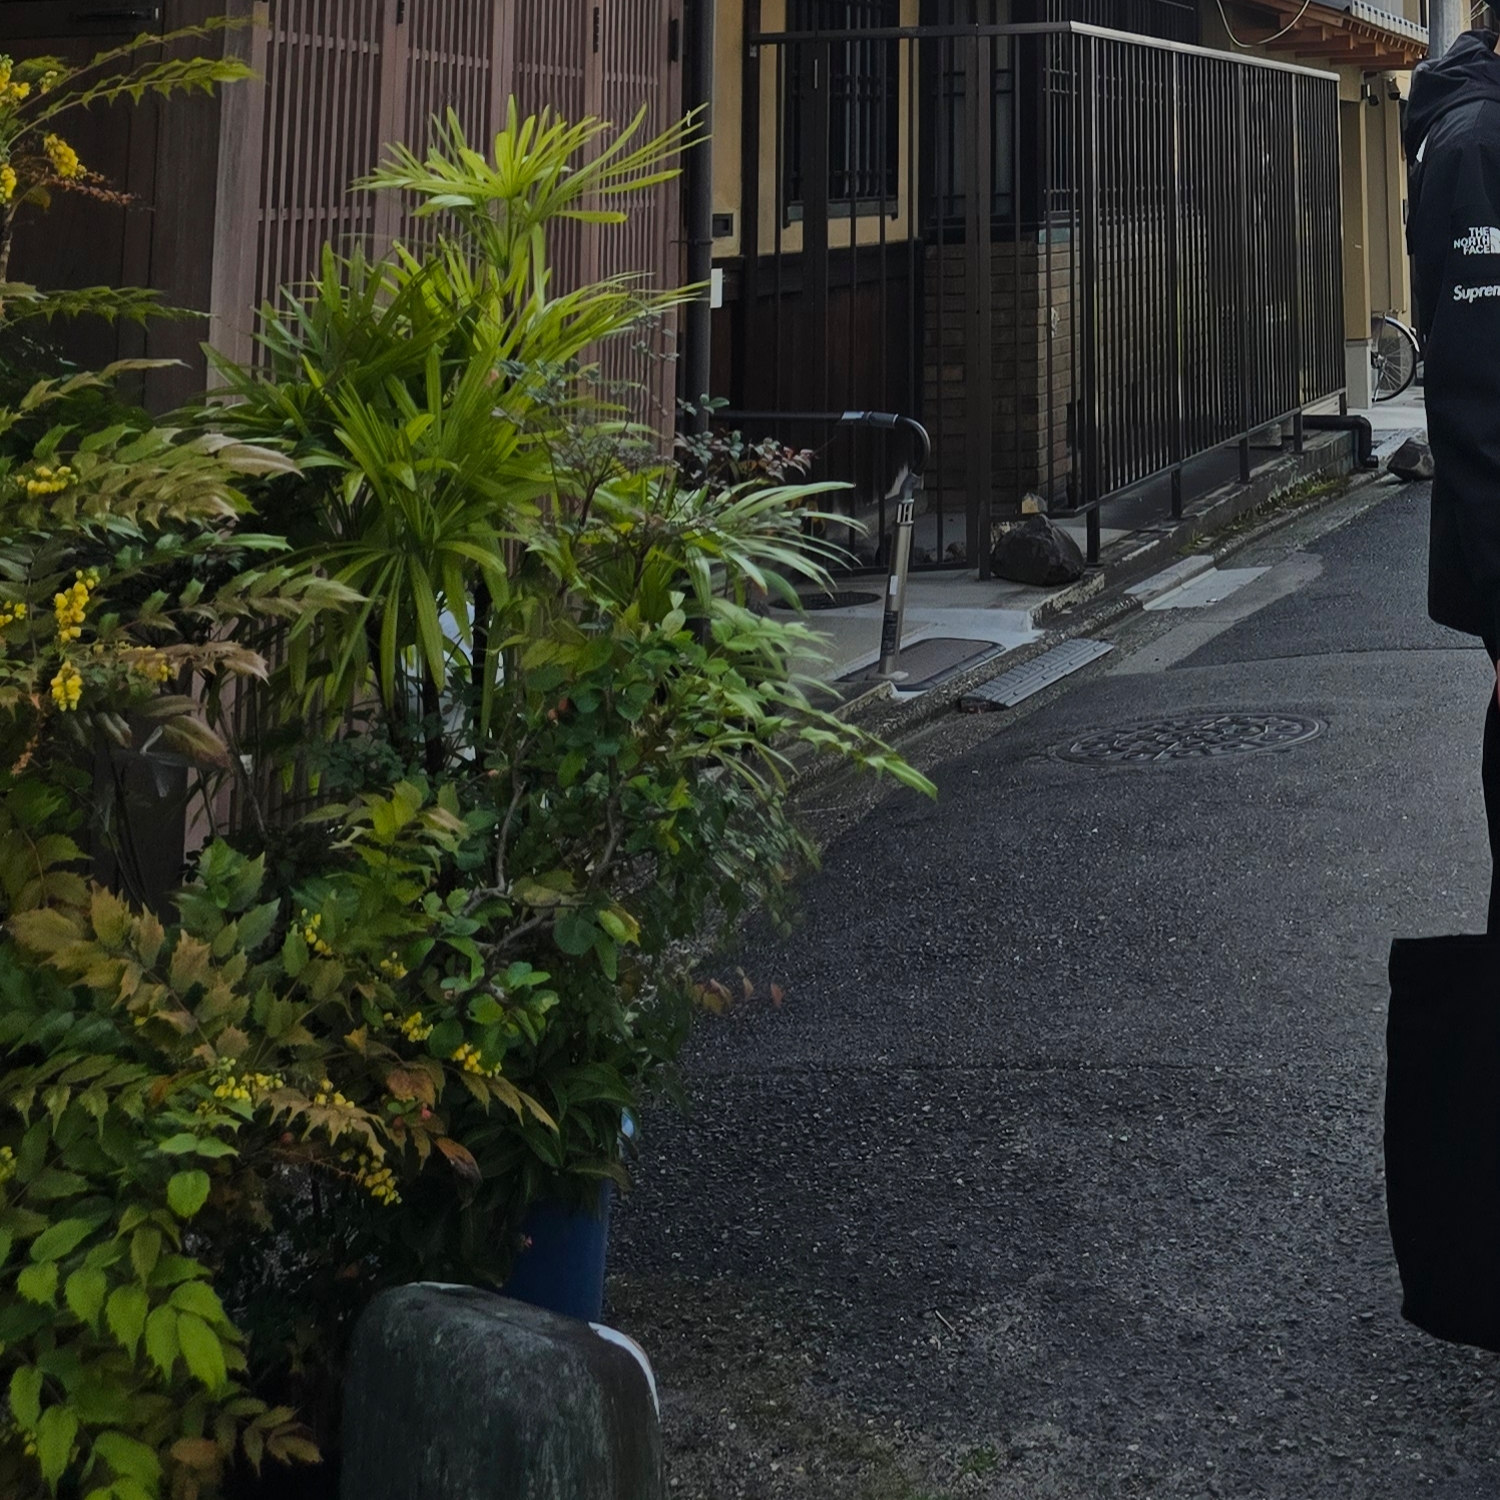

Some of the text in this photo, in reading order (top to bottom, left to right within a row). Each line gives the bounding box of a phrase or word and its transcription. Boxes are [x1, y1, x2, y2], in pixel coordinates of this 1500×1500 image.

[1468, 226, 1490, 238] THE
[1453, 234, 1490, 249] NORTH
[1463, 245, 1490, 256] FACE
